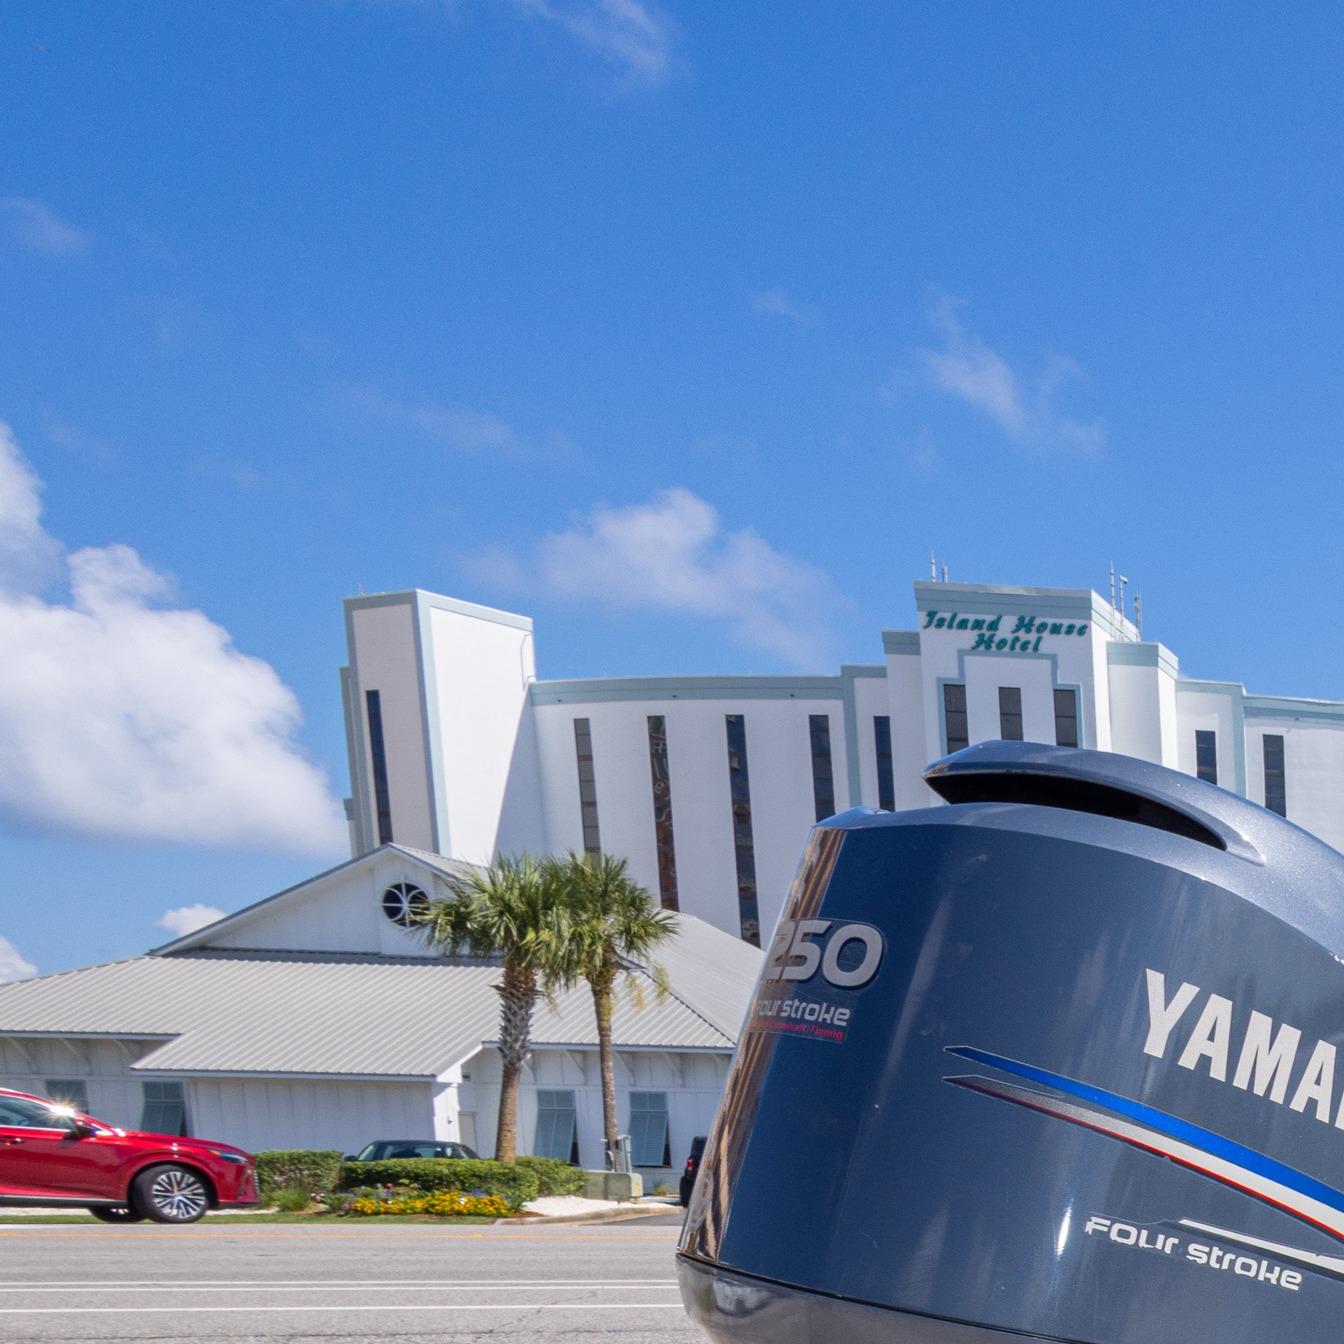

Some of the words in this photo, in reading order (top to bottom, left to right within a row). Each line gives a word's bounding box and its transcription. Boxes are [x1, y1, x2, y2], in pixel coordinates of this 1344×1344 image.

[922, 610, 1002, 632] Island
[1011, 615, 1089, 637] House
[971, 633, 1043, 653] Hotel
[761, 920, 883, 987] 250
[781, 999, 850, 1027] stroke
[1186, 1242, 1302, 1291] stroke
